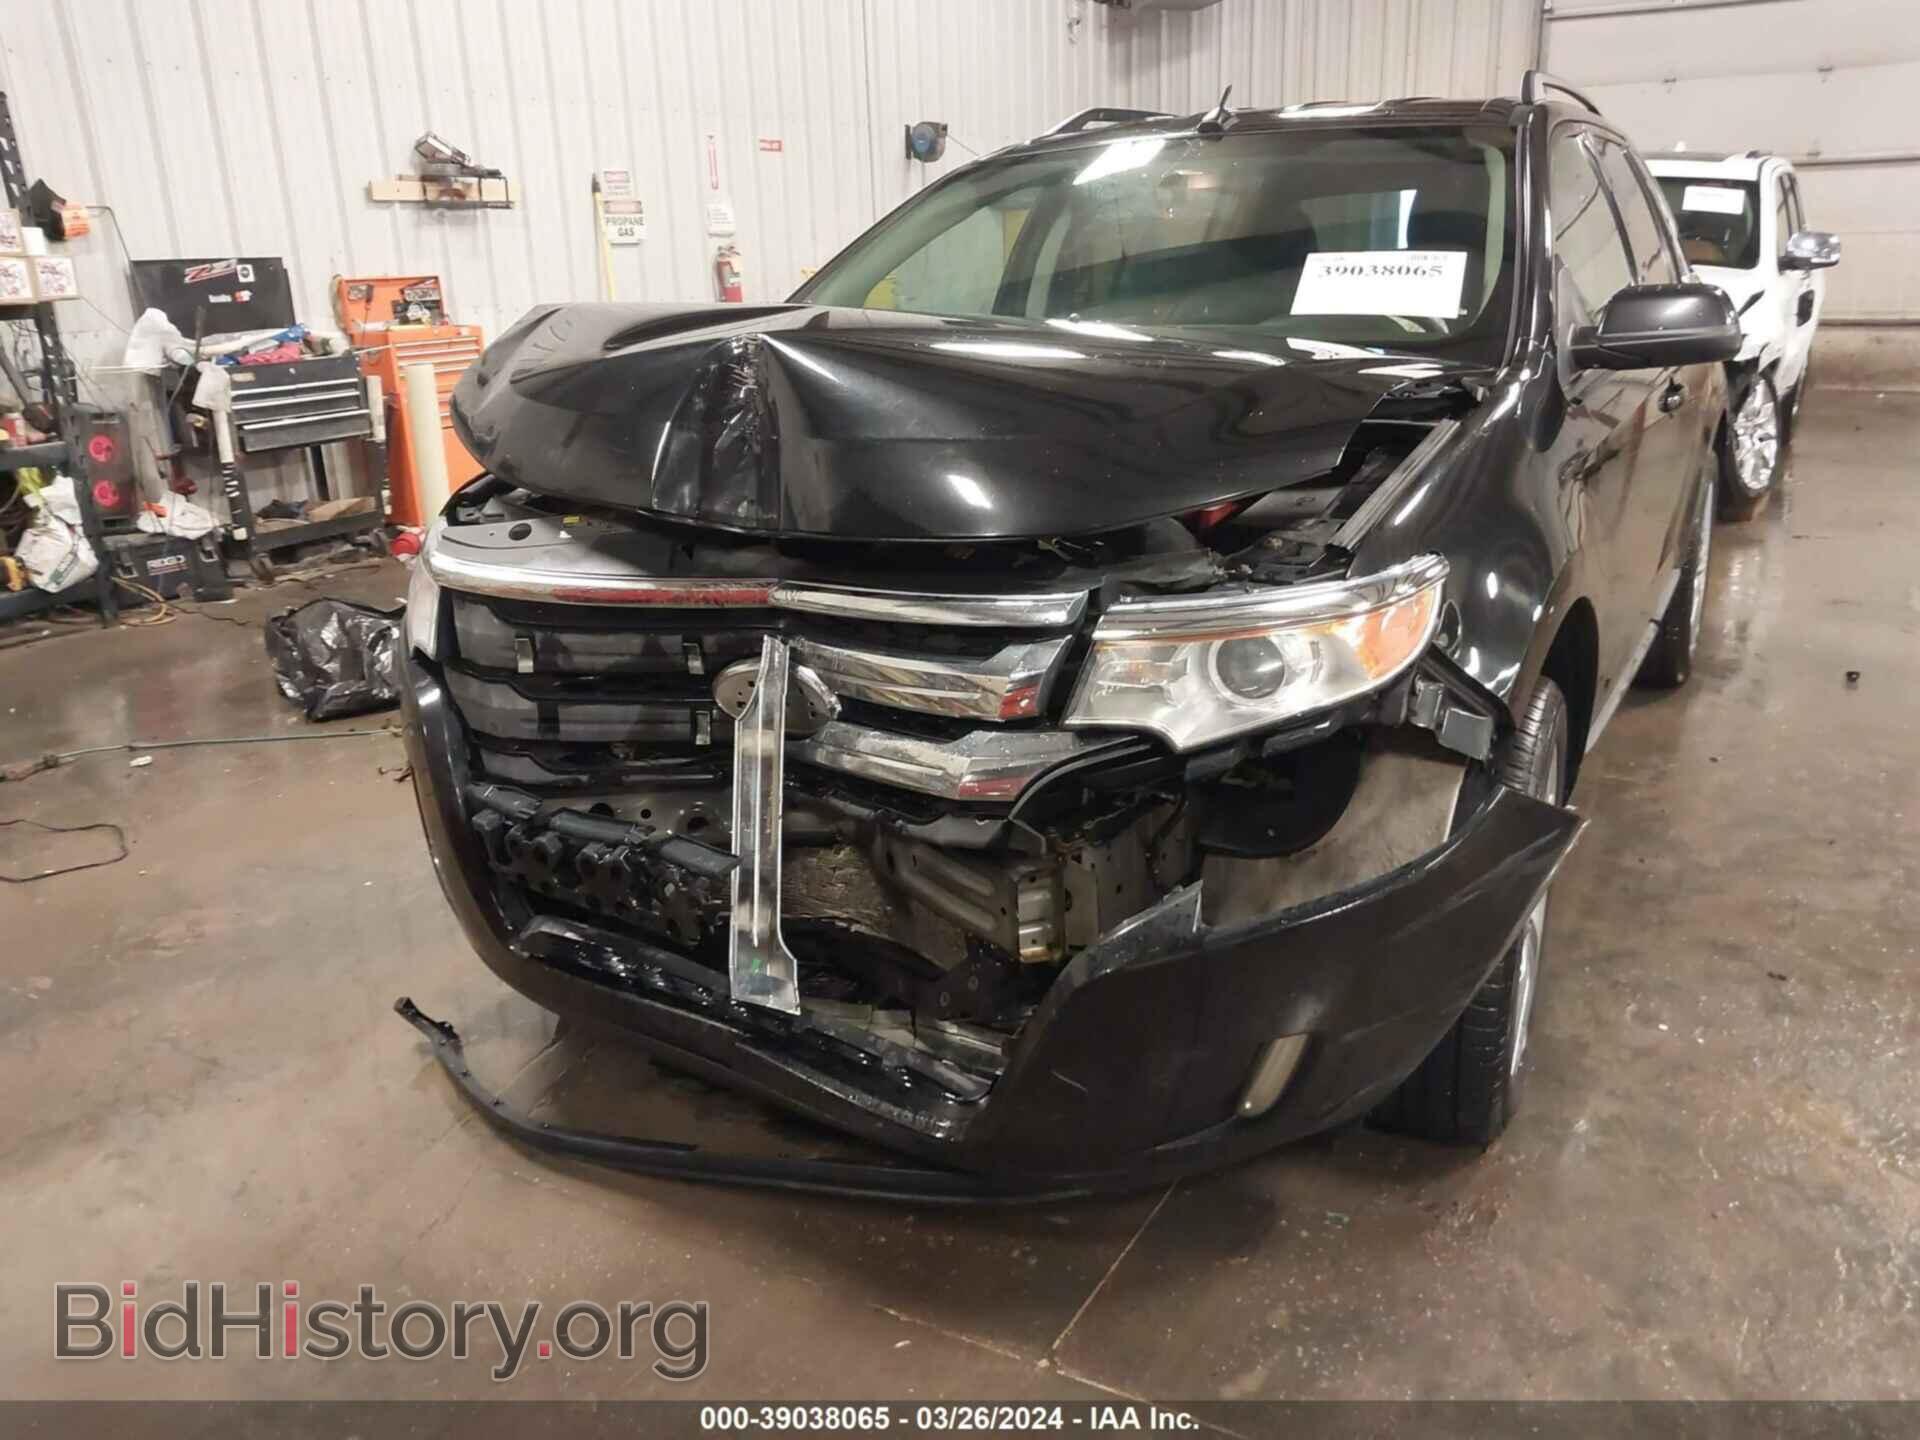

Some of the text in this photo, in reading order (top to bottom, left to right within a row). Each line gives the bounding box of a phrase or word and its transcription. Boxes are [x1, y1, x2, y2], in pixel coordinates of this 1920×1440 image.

[605, 215, 645, 226] PROPANE
[617, 227, 636, 237] GAS
[1317, 263, 1443, 278] 39038065
